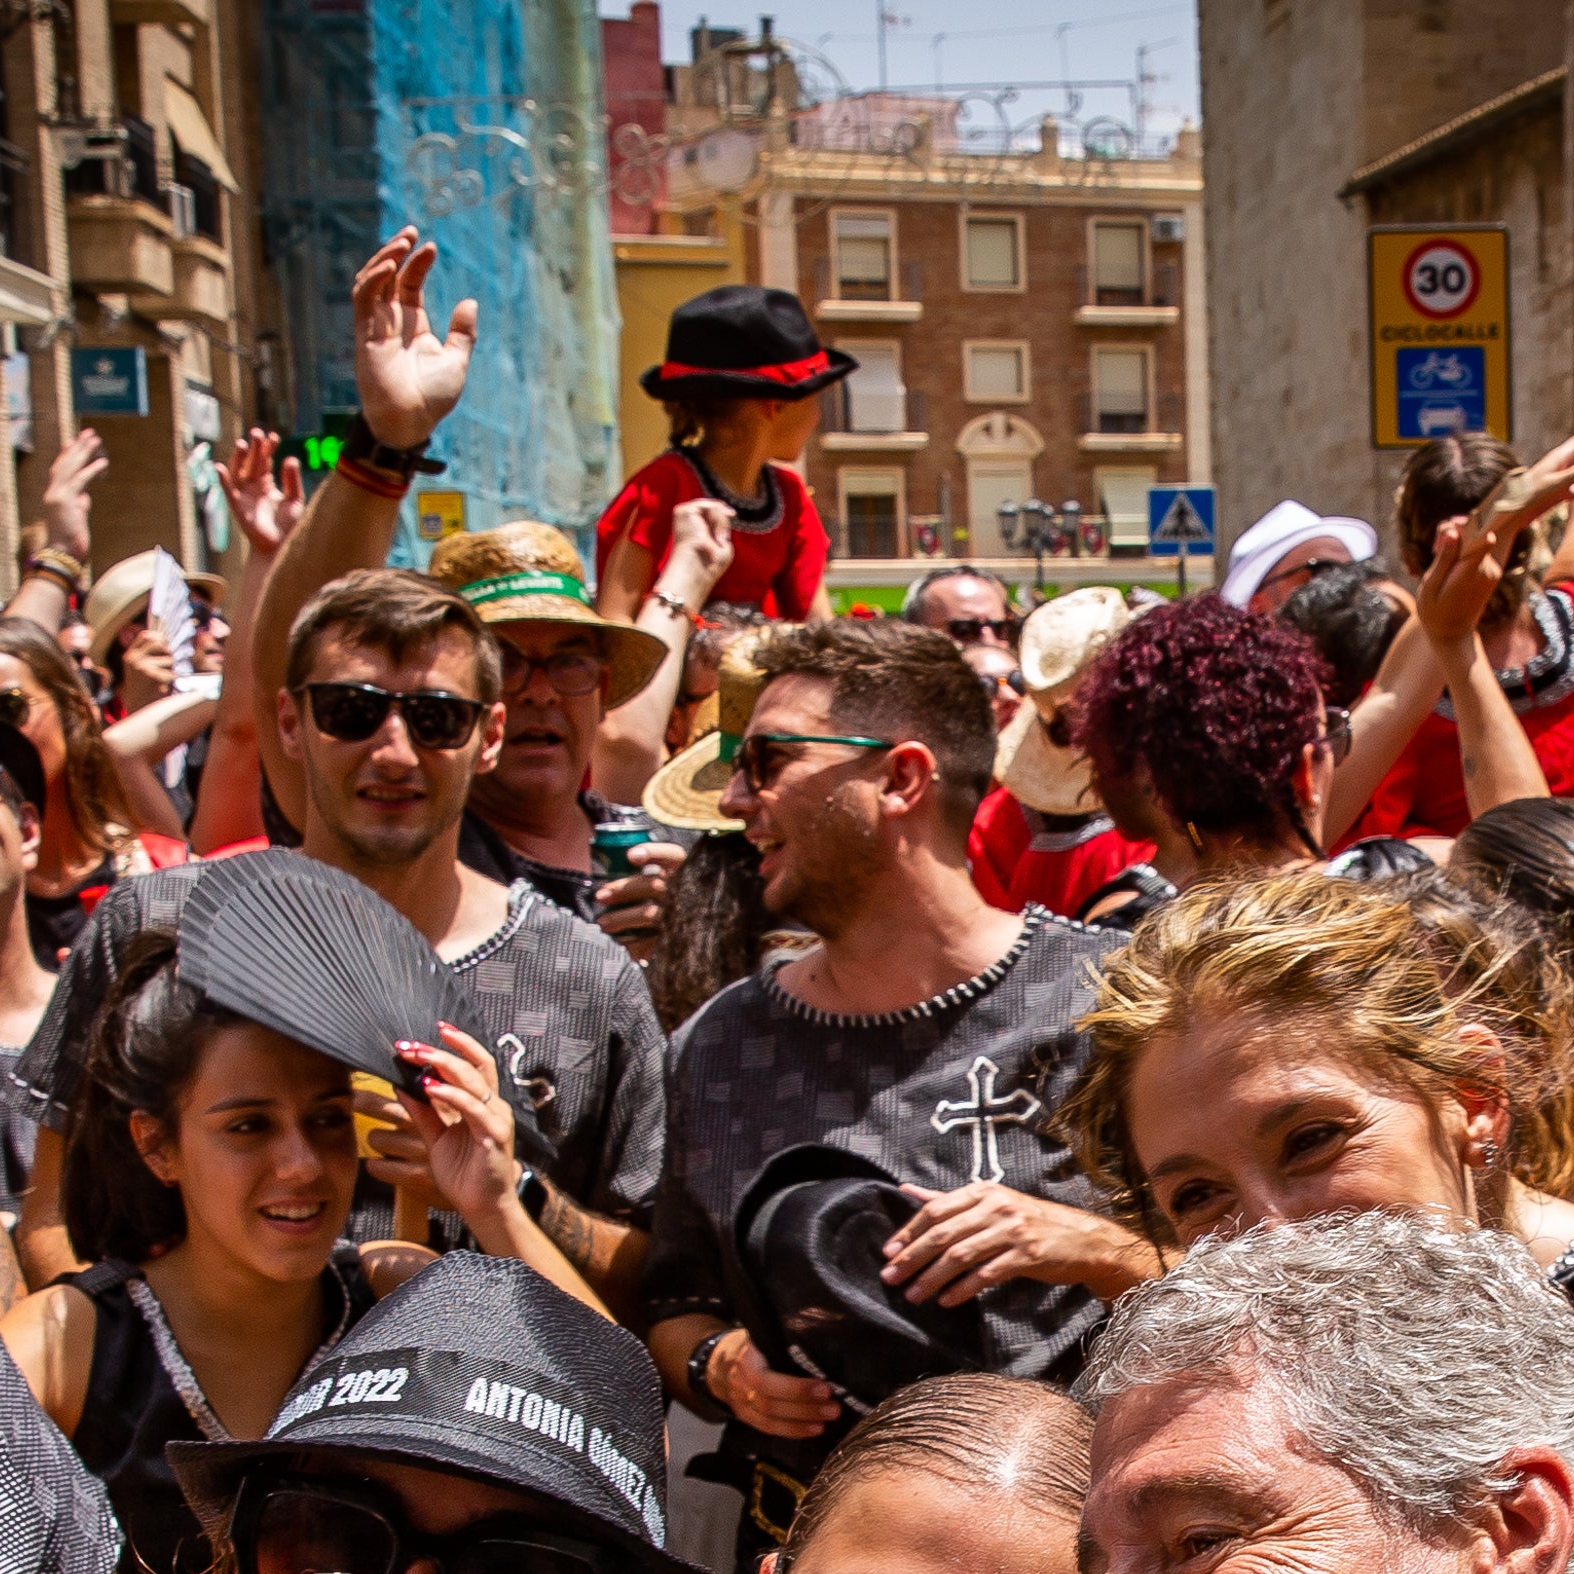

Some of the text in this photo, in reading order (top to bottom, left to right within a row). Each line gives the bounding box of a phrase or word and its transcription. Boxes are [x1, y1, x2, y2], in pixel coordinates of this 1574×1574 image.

[1416, 261, 1467, 295] 30
[1379, 321, 1500, 342] CICLOCALLE
[327, 1366, 410, 1408] 2022
[463, 1376, 586, 1454] ANTONIA
